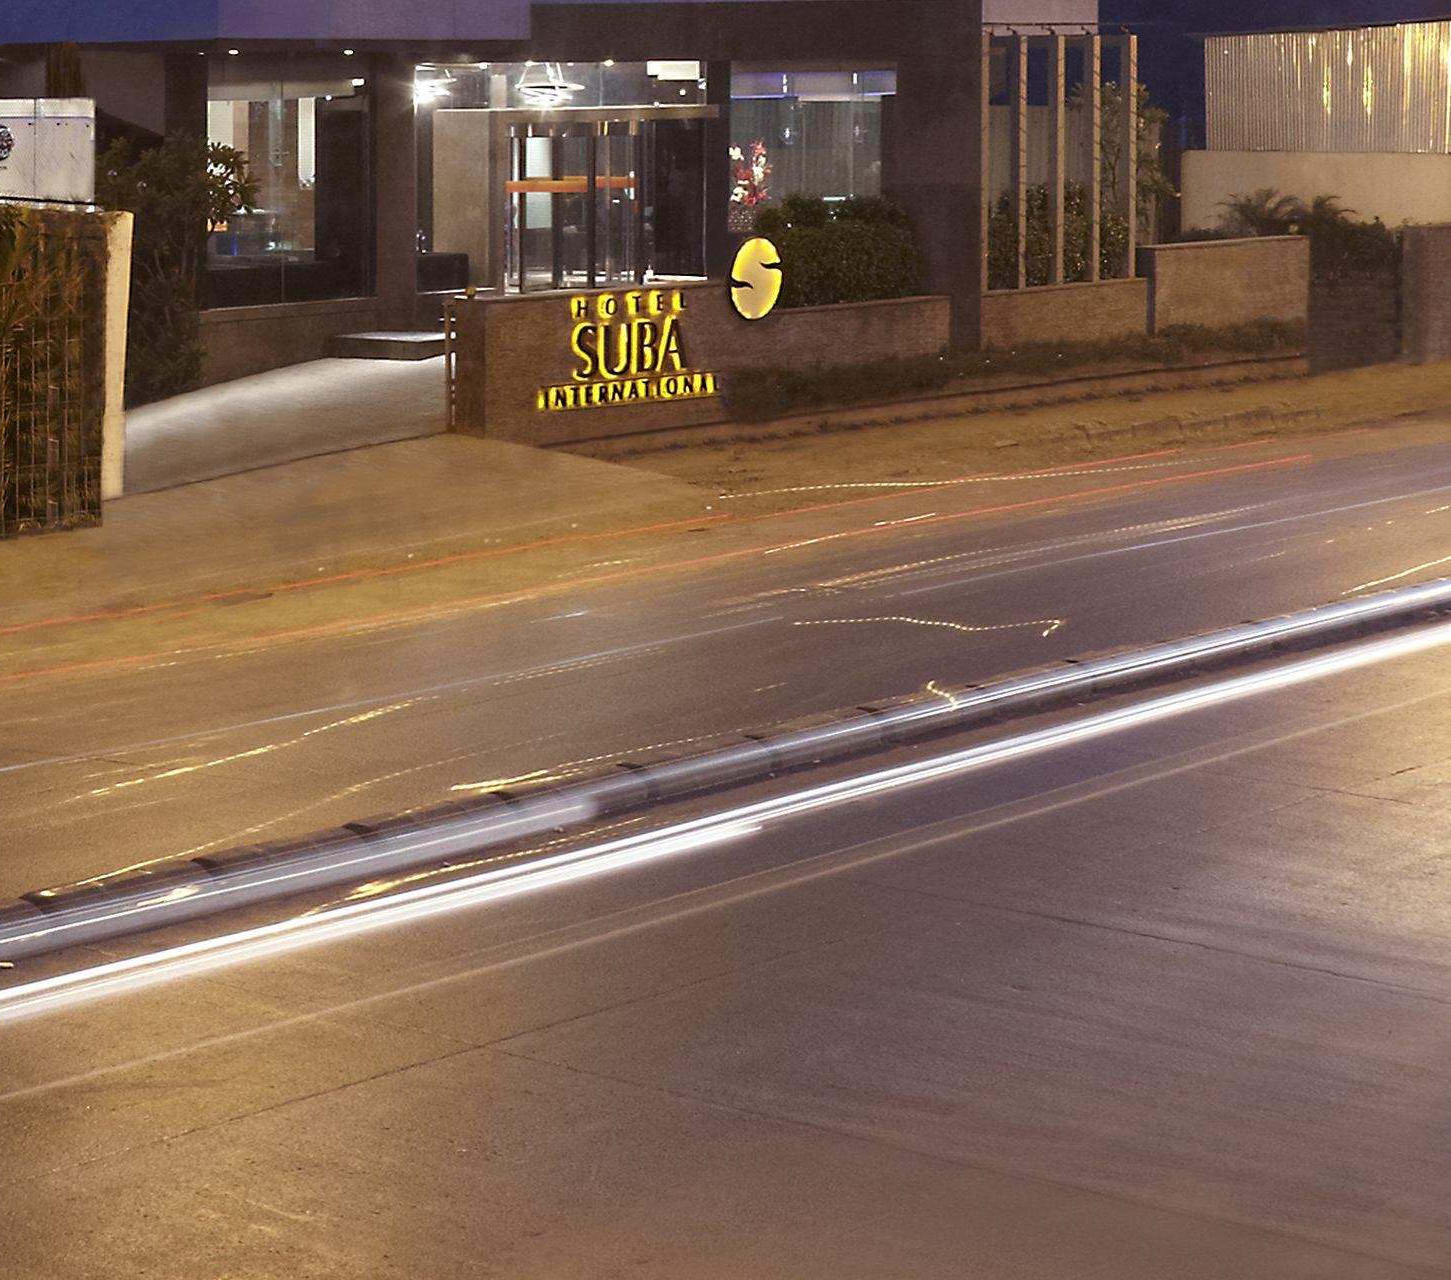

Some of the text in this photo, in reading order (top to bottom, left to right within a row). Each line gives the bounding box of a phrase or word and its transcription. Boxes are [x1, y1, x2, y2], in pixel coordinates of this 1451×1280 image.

[570, 290, 688, 319] HOTEL
[571, 315, 688, 381] SUBA
[536, 372, 721, 410] INTERNATIONAL
